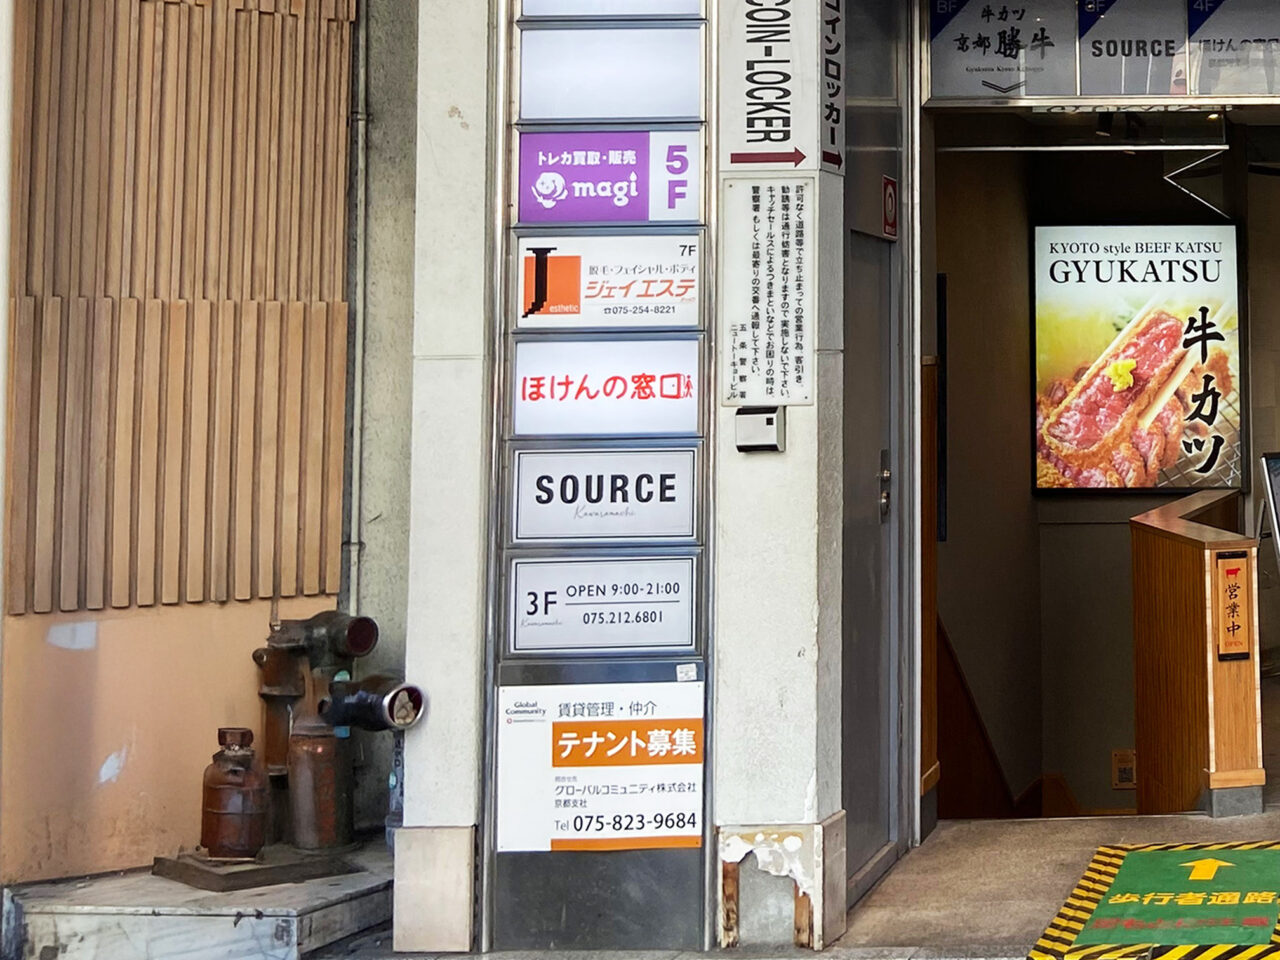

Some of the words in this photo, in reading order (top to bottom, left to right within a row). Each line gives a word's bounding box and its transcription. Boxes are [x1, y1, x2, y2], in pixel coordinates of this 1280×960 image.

[937, 0, 957, 13] BF
[981, 4, 1026, 23] 牛カツ
[953, 26, 1055, 60] 京都勝牛
[1091, 39, 1175, 57] SOURCE
[538, 150, 637, 166] トレカ買取・販売
[572, 171, 638, 207] magi
[679, 245, 696, 256] 7F
[1050, 242, 1100, 254] KYOTO
[1103, 243, 1131, 256] style
[1135, 242, 1171, 253] BEEF
[1175, 242, 1222, 253] KATSU
[1049, 259, 1222, 284] GYUKATSU
[584, 279, 696, 298] ジェイエステ
[549, 304, 579, 313] esthetic
[612, 305, 676, 314] 075-254-8221
[522, 373, 684, 401] ほけんの窓口
[1182, 306, 1225, 474] 牛カツ
[535, 473, 676, 504] SOURCE
[566, 585, 606, 597] OPEN
[611, 582, 680, 595] 9:00-21:00
[526, 591, 557, 616] 3F
[1225, 582, 1241, 637] 営業中
[583, 610, 663, 625] 075.212.6801
[558, 700, 657, 717] 賃貸管理・仲介
[558, 728, 697, 758] テナント募集
[555, 782, 697, 796] グローバルコミュニティ株式会社
[555, 799, 587, 808] 京都支社
[555, 820, 569, 831] Tel
[573, 812, 697, 831] 075-823-9684
[1108, 892, 1277, 906] 歩行者通路
